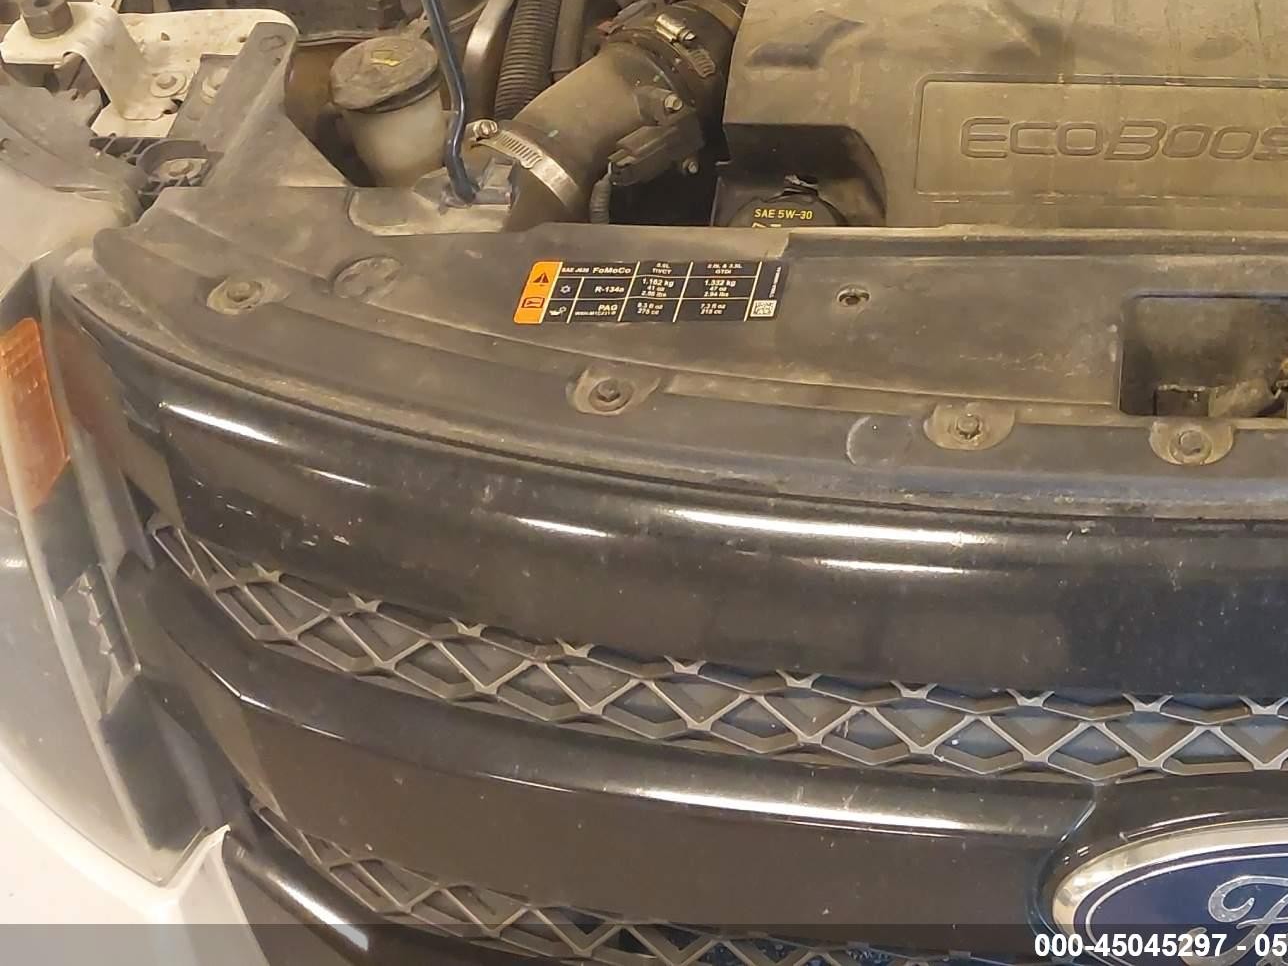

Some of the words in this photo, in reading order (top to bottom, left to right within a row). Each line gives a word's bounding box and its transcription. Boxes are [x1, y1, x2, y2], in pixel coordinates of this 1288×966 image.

[754, 208, 775, 218] SAE
[777, 210, 813, 220] 5W-30
[664, 280, 674, 288] kg
